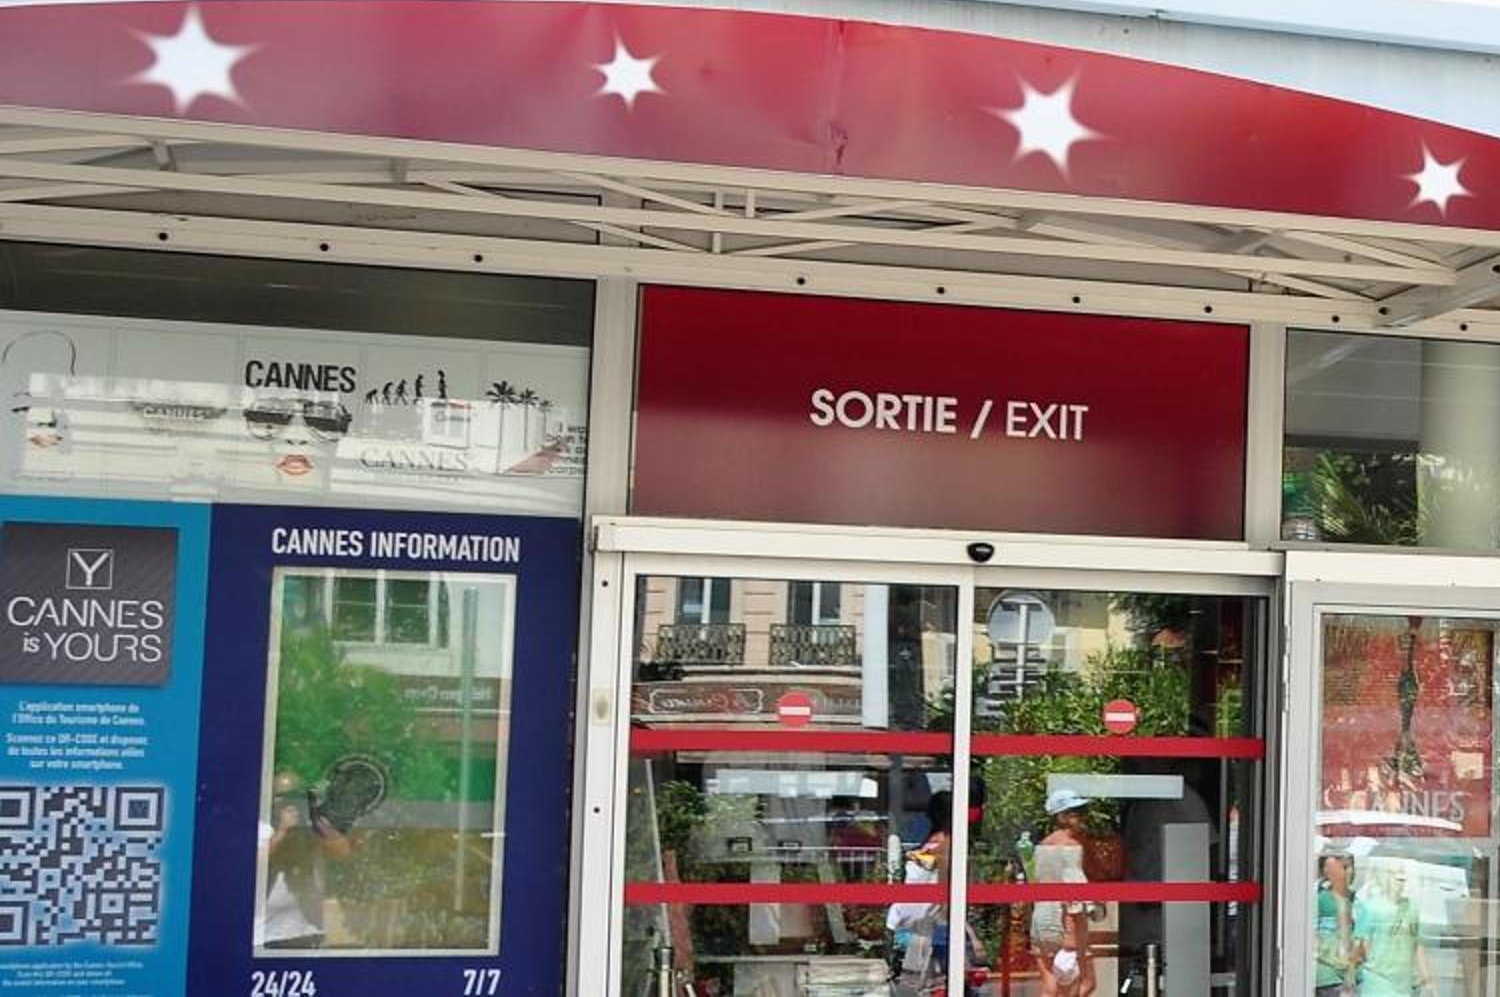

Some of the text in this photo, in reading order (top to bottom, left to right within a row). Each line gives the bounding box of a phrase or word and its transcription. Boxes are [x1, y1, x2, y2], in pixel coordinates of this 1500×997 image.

[244, 359, 357, 394] CANNES
[809, 388, 1089, 441] SORTIE / EXIT
[271, 527, 521, 563] CANNES INFORMATION
[7, 596, 164, 630] CANNES
[23, 632, 162, 663] is YOURS
[251, 968, 501, 997] 24/24 7/7
